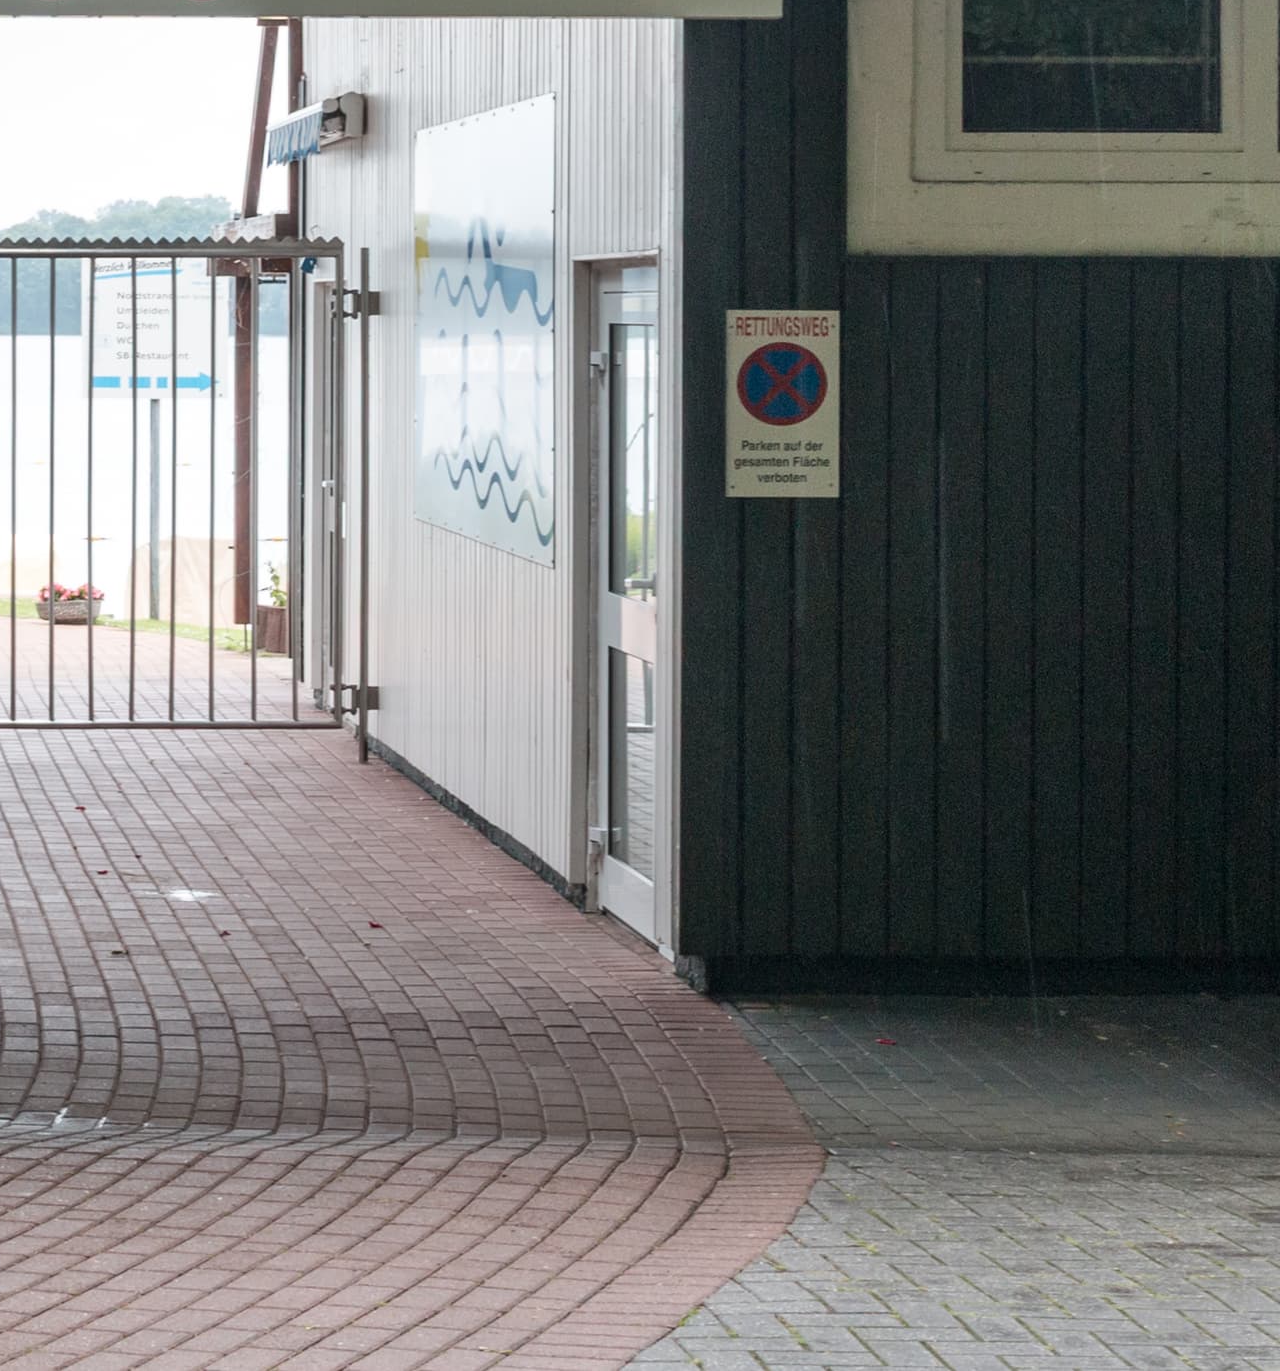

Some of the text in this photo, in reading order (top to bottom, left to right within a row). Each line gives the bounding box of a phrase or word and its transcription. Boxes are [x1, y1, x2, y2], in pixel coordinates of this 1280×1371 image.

[116, 321, 160, 331] Duchen
[736, 316, 830, 337] RETTUNGSWEG
[741, 440, 824, 451] Parken auf der
[734, 456, 831, 470] gesamten Fläche
[757, 472, 808, 483] verboten
